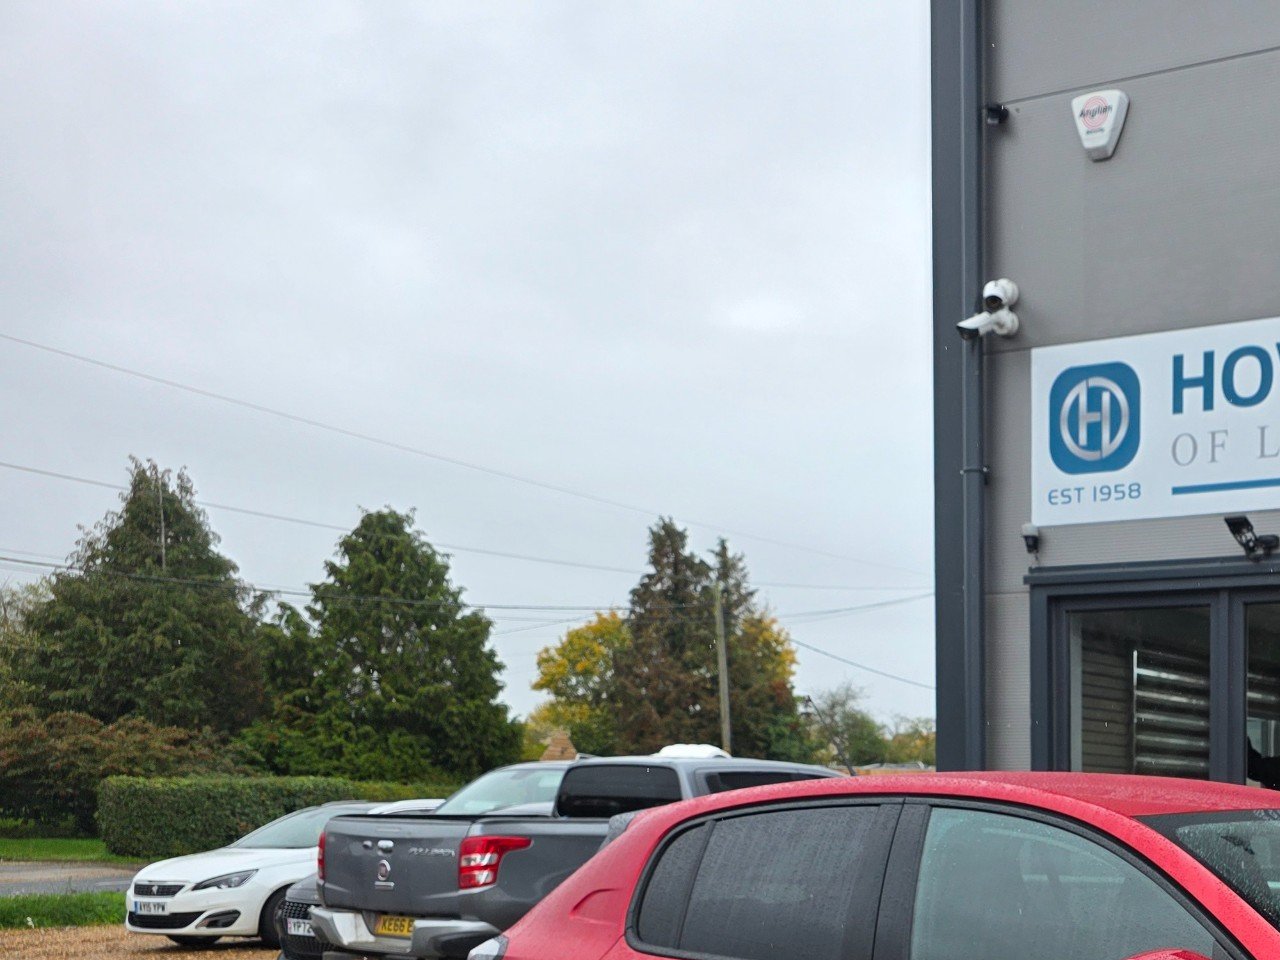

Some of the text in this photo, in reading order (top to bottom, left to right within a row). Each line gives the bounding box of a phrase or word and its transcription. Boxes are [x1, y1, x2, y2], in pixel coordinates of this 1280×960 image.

[1170, 428, 1230, 467] OF
[1047, 482, 1142, 506] EST 1958
[381, 916, 404, 933] KE66
